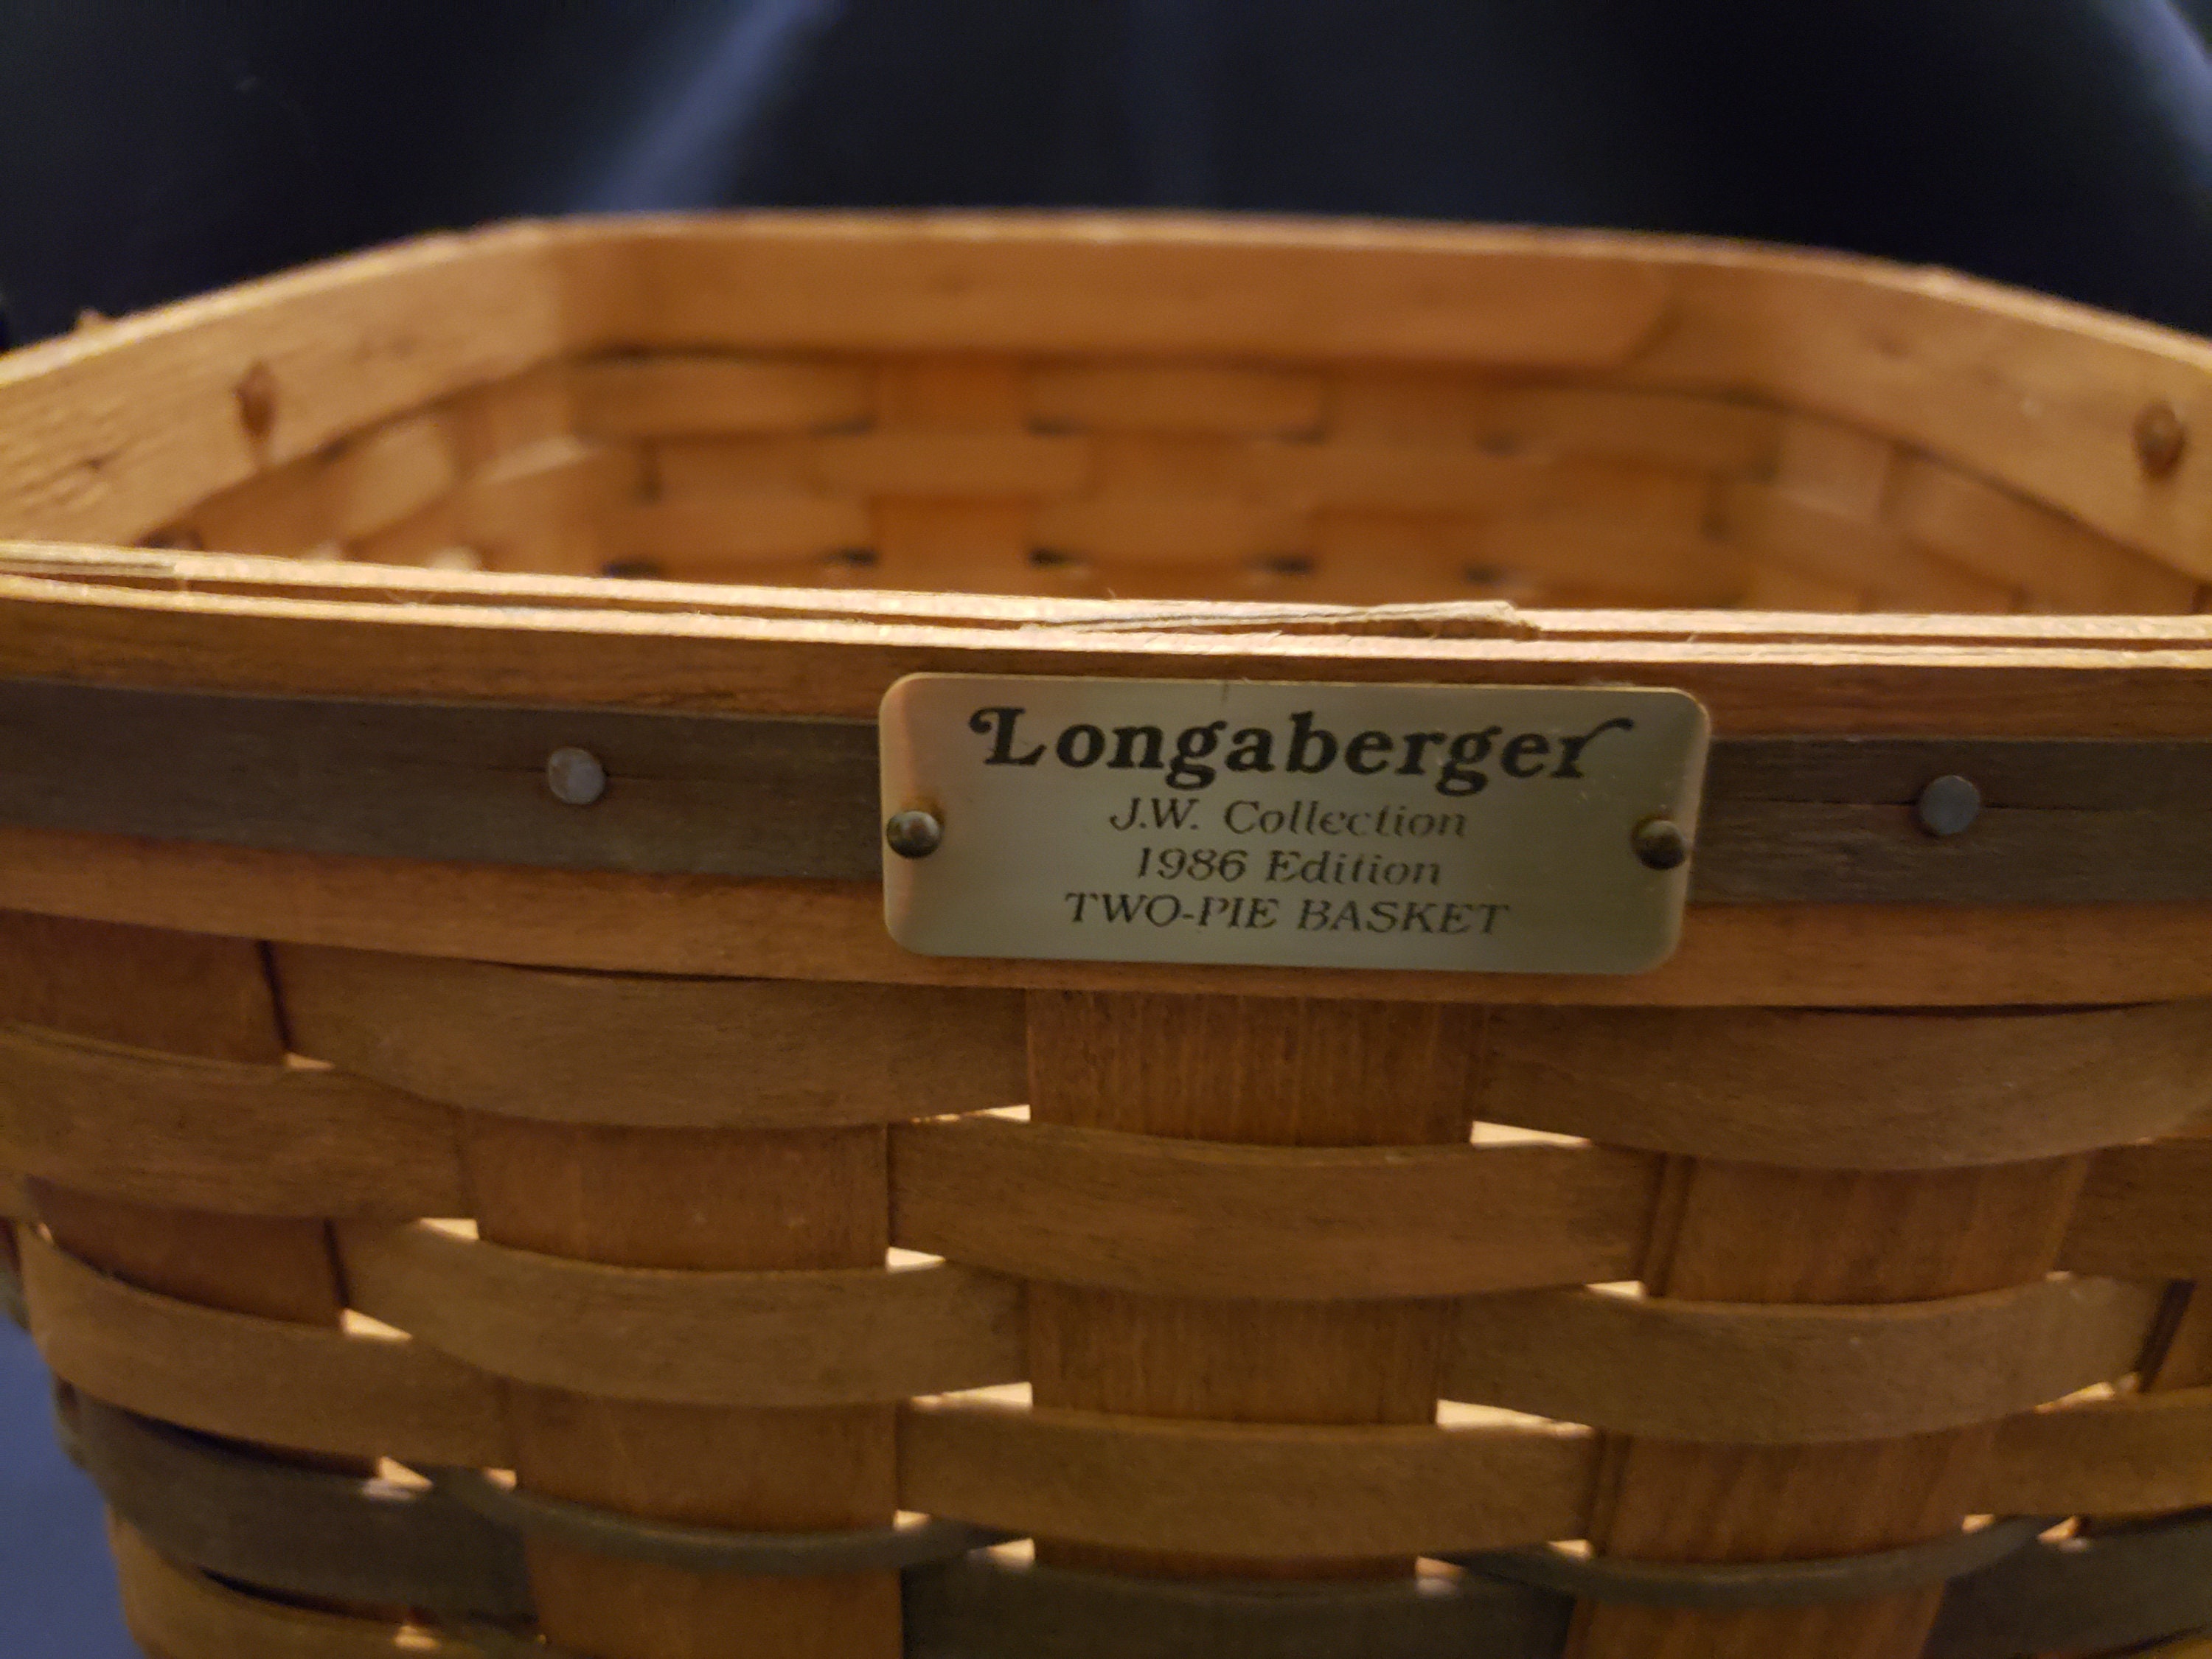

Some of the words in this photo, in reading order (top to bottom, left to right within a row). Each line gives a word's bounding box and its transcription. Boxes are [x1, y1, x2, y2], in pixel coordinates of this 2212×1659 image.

[969, 706, 1634, 799] Longaberger
[1109, 799, 1200, 832] J.W.
[1224, 800, 1467, 839] Collection
[1137, 847, 1246, 883] 1986
[1265, 850, 1442, 887] Edition
[1064, 892, 1278, 930] TWO-PIE
[1298, 897, 1510, 935] BASKET
